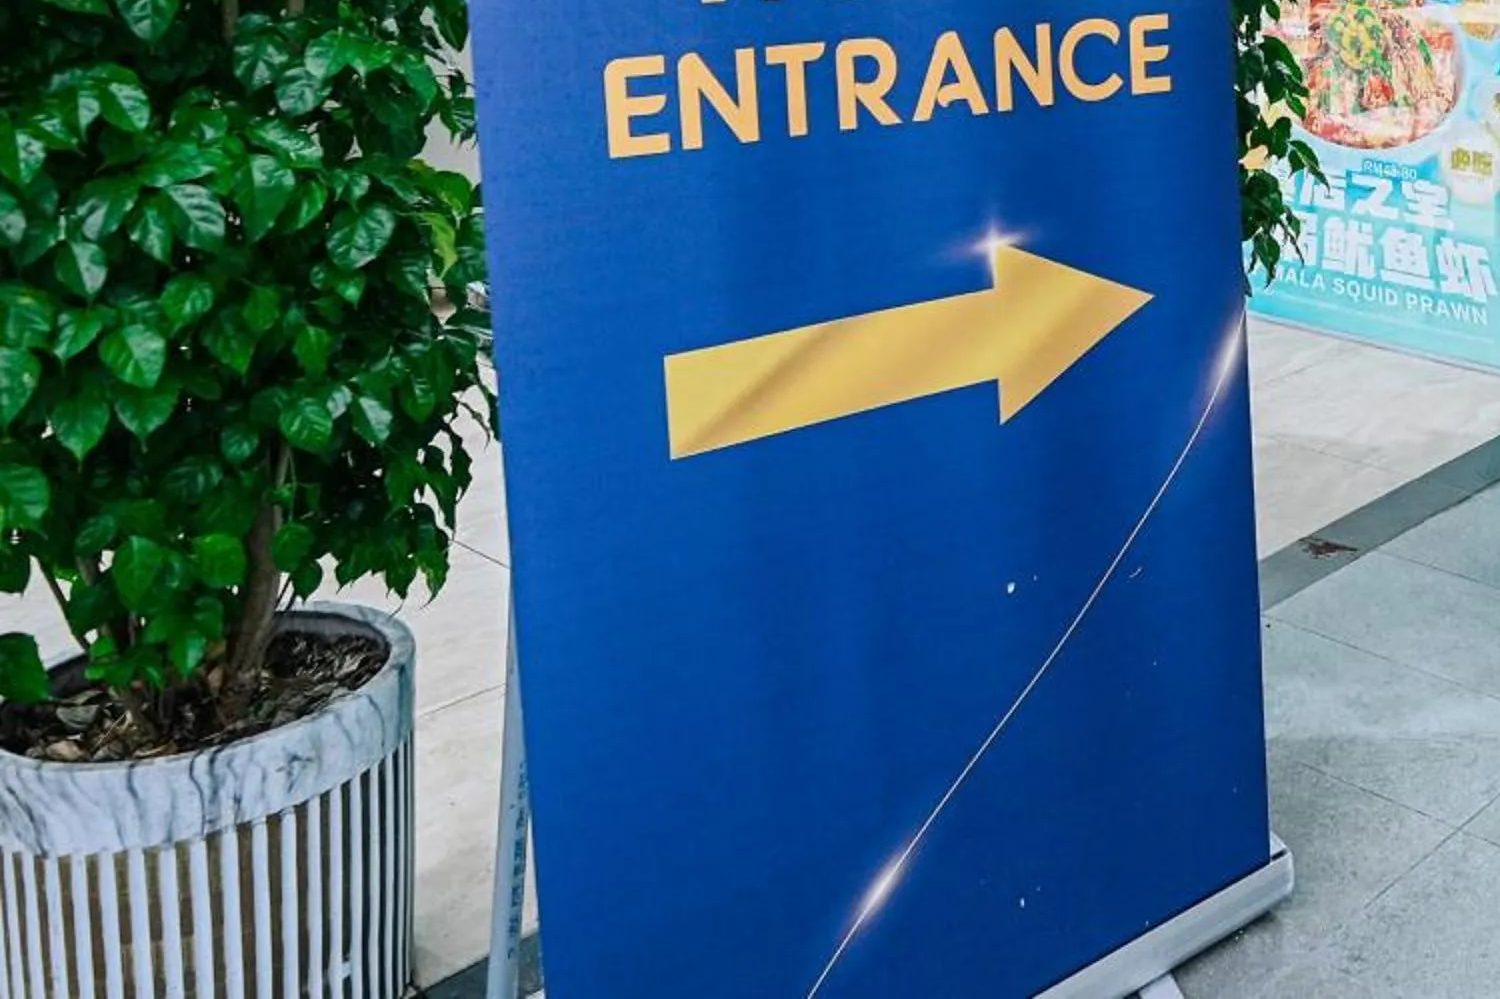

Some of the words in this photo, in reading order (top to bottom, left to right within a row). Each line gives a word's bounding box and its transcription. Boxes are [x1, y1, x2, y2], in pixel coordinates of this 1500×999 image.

[603, 13, 1172, 159] ENTRANCE
[1332, 277, 1399, 306] SQUID
[1405, 294, 1488, 326] PRAWN
